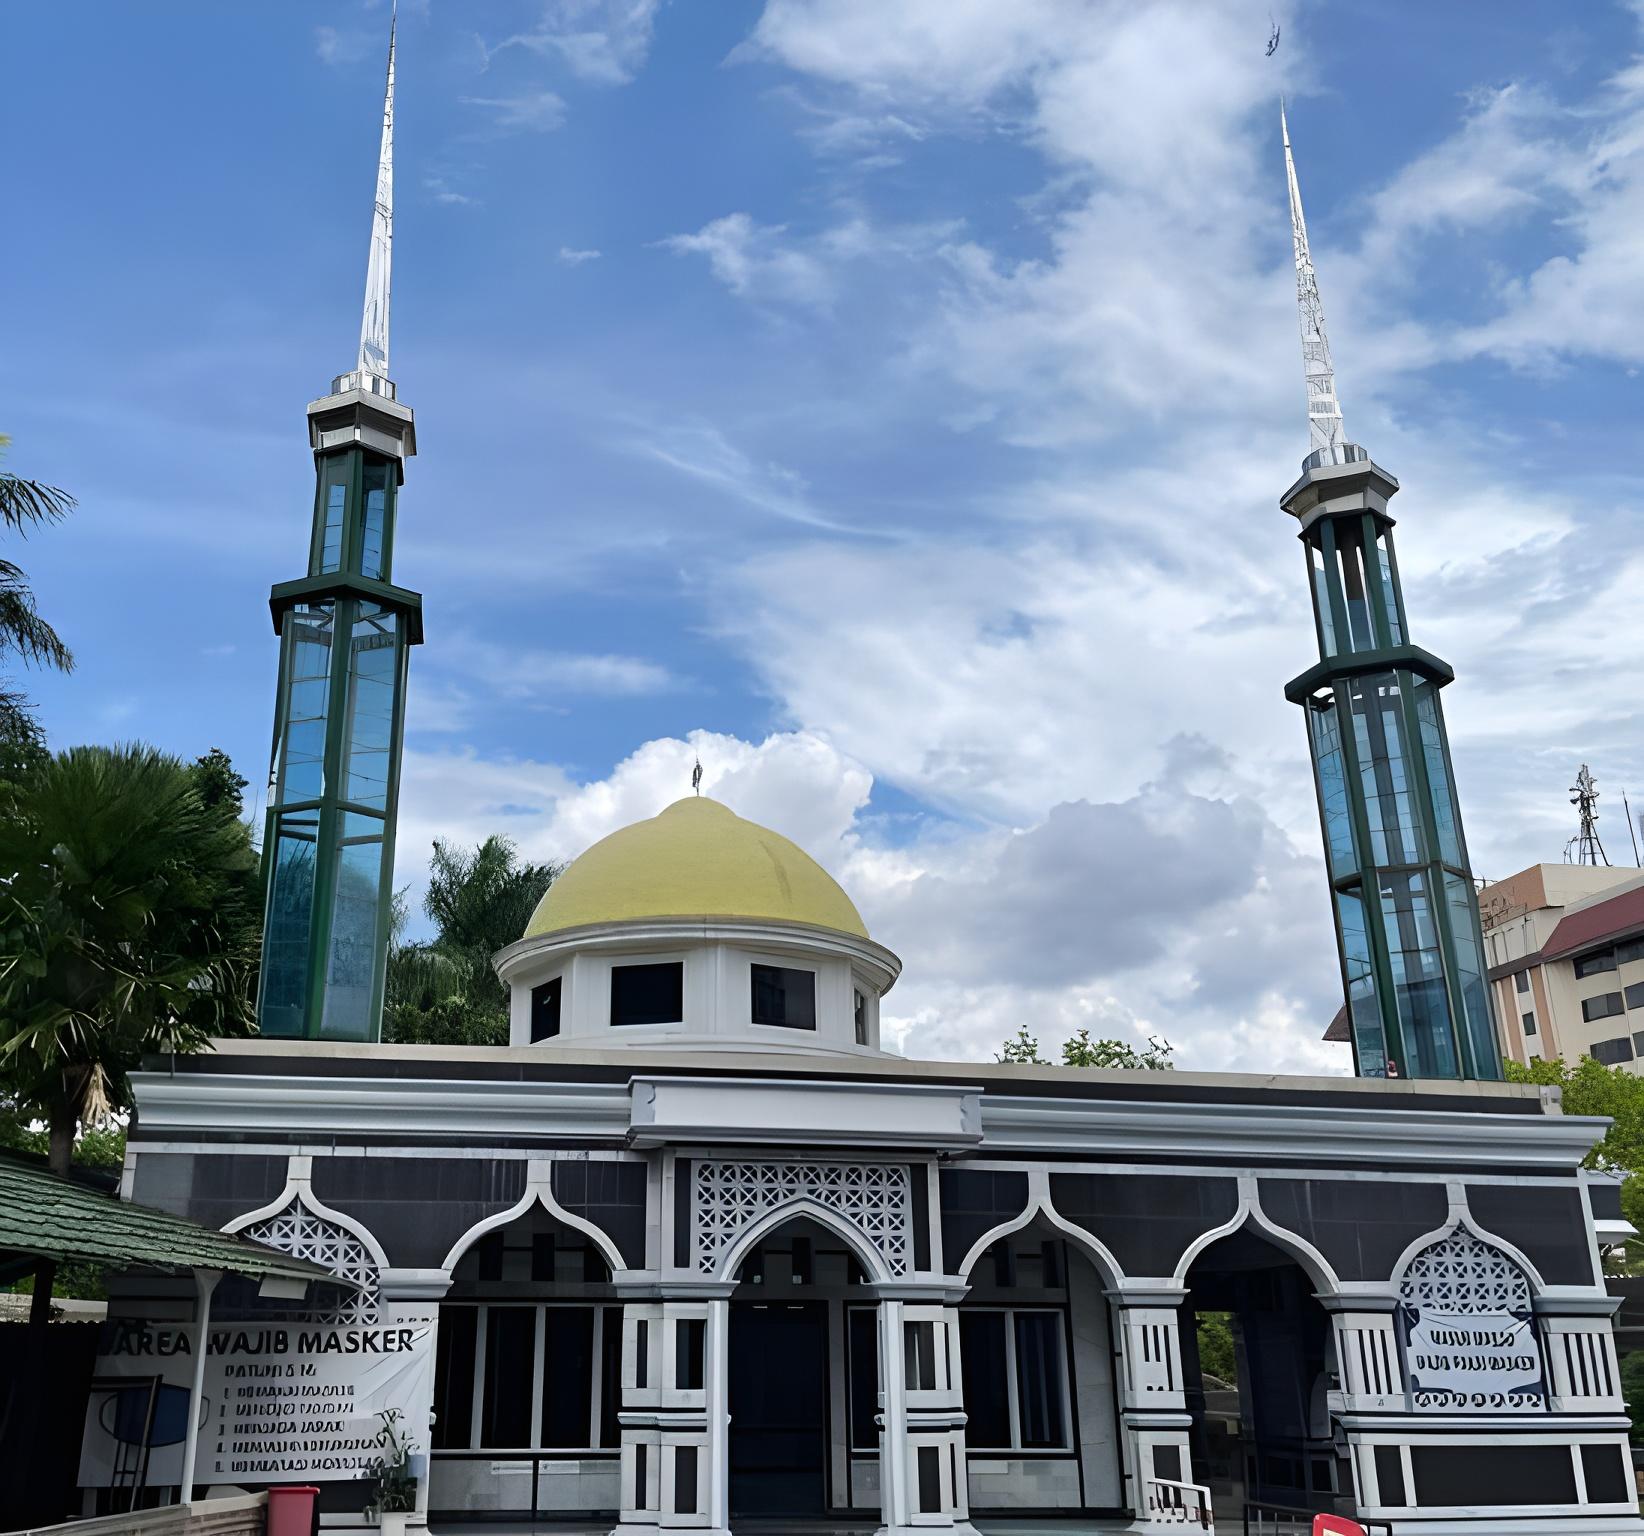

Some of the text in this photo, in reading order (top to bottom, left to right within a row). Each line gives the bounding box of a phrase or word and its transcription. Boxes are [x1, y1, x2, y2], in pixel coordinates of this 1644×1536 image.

[113, 1328, 415, 1355] AREA WAJIB MASKER
